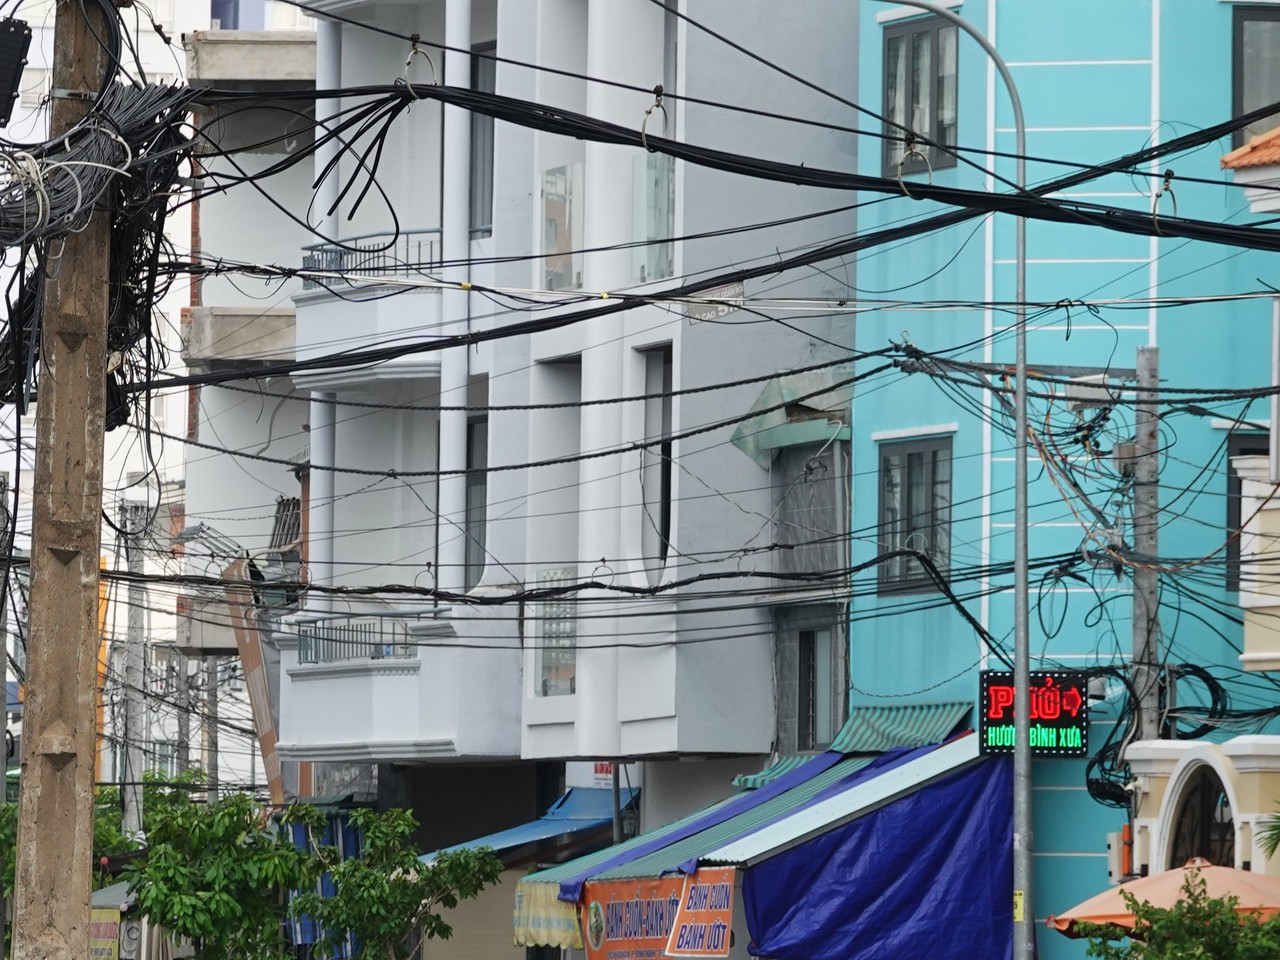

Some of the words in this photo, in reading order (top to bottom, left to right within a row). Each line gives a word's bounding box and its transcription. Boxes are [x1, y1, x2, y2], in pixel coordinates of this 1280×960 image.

[1029, 723, 1057, 748] BÌNH
[1059, 725, 1082, 748] XƯA
[685, 878, 709, 912] BÁNH
[709, 873, 731, 912] CUỐN
[675, 917, 705, 951] BÁNH
[706, 916, 728, 951] ƯỚT
